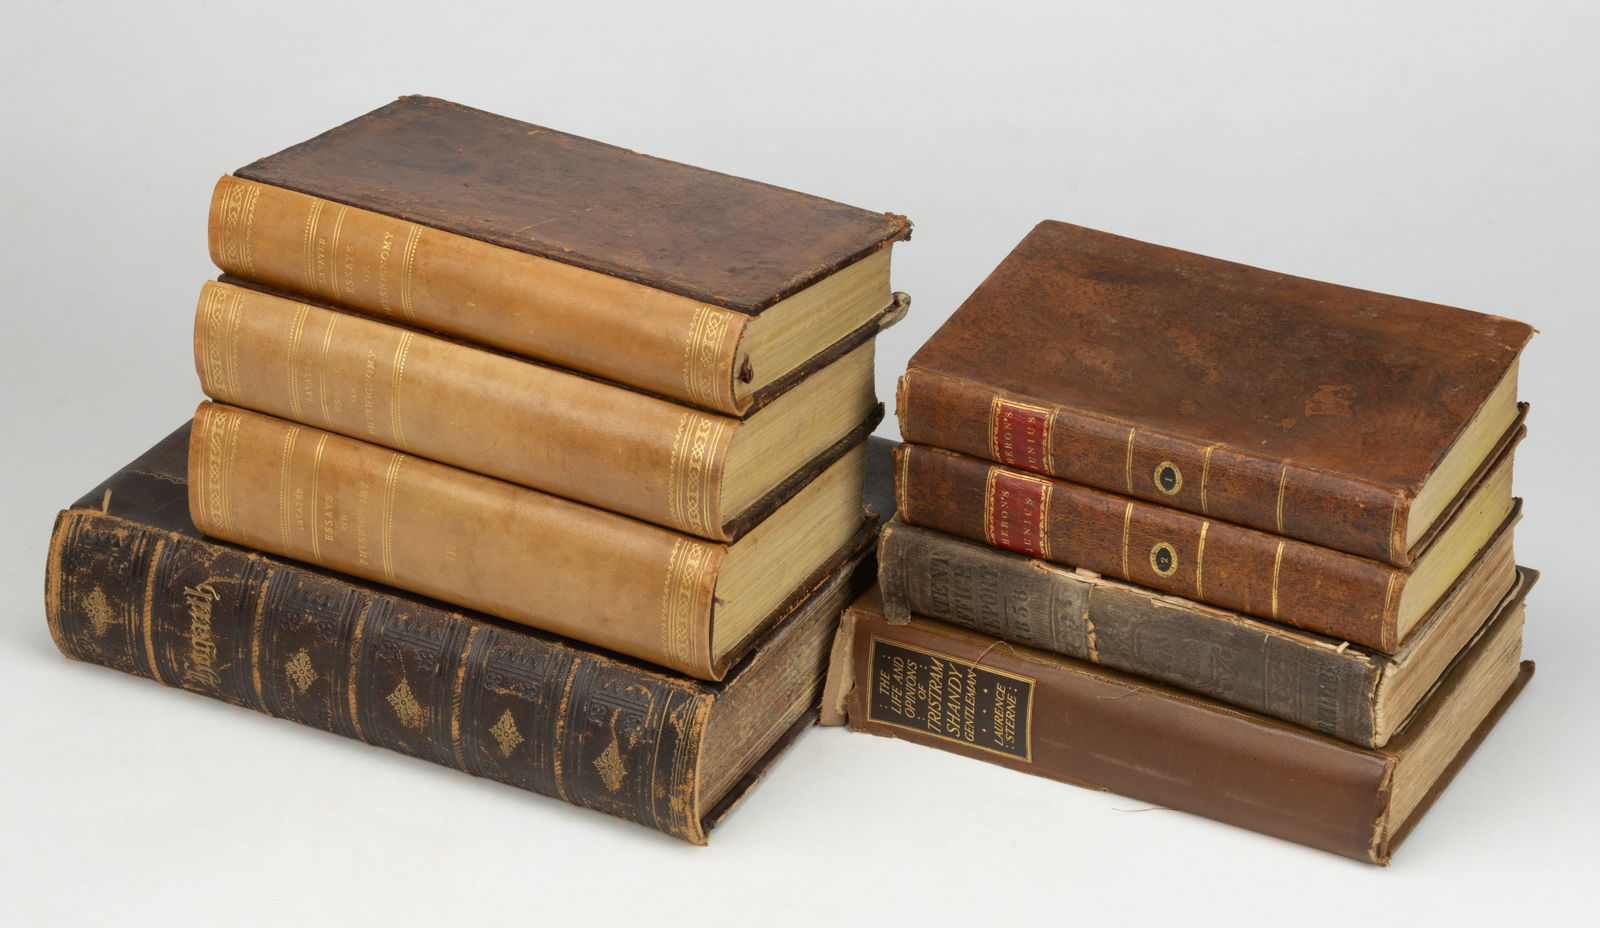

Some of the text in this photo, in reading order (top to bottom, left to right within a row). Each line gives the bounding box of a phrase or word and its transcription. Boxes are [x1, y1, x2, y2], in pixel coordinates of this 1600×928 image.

[346, 245, 355, 294] ESSAYS
[1026, 416, 1039, 471] JUNIUS
[325, 494, 334, 541] ESSAYS
[341, 514, 349, 531] ON
[1000, 490, 1011, 546] HERON'S
[1023, 497, 1034, 553] JUNIUS
[879, 669, 891, 696] THE
[890, 656, 905, 715] LIFE AND
[904, 658, 918, 719] OPINIONS
[917, 683, 927, 701] OF
[927, 656, 945, 734] TRISTRAM
[946, 662, 964, 738] SHANDY
[964, 670, 978, 743] GENTLEMAN
[993, 682, 1007, 747] LAURENCE
[1005, 693, 1017, 744] STERNE
